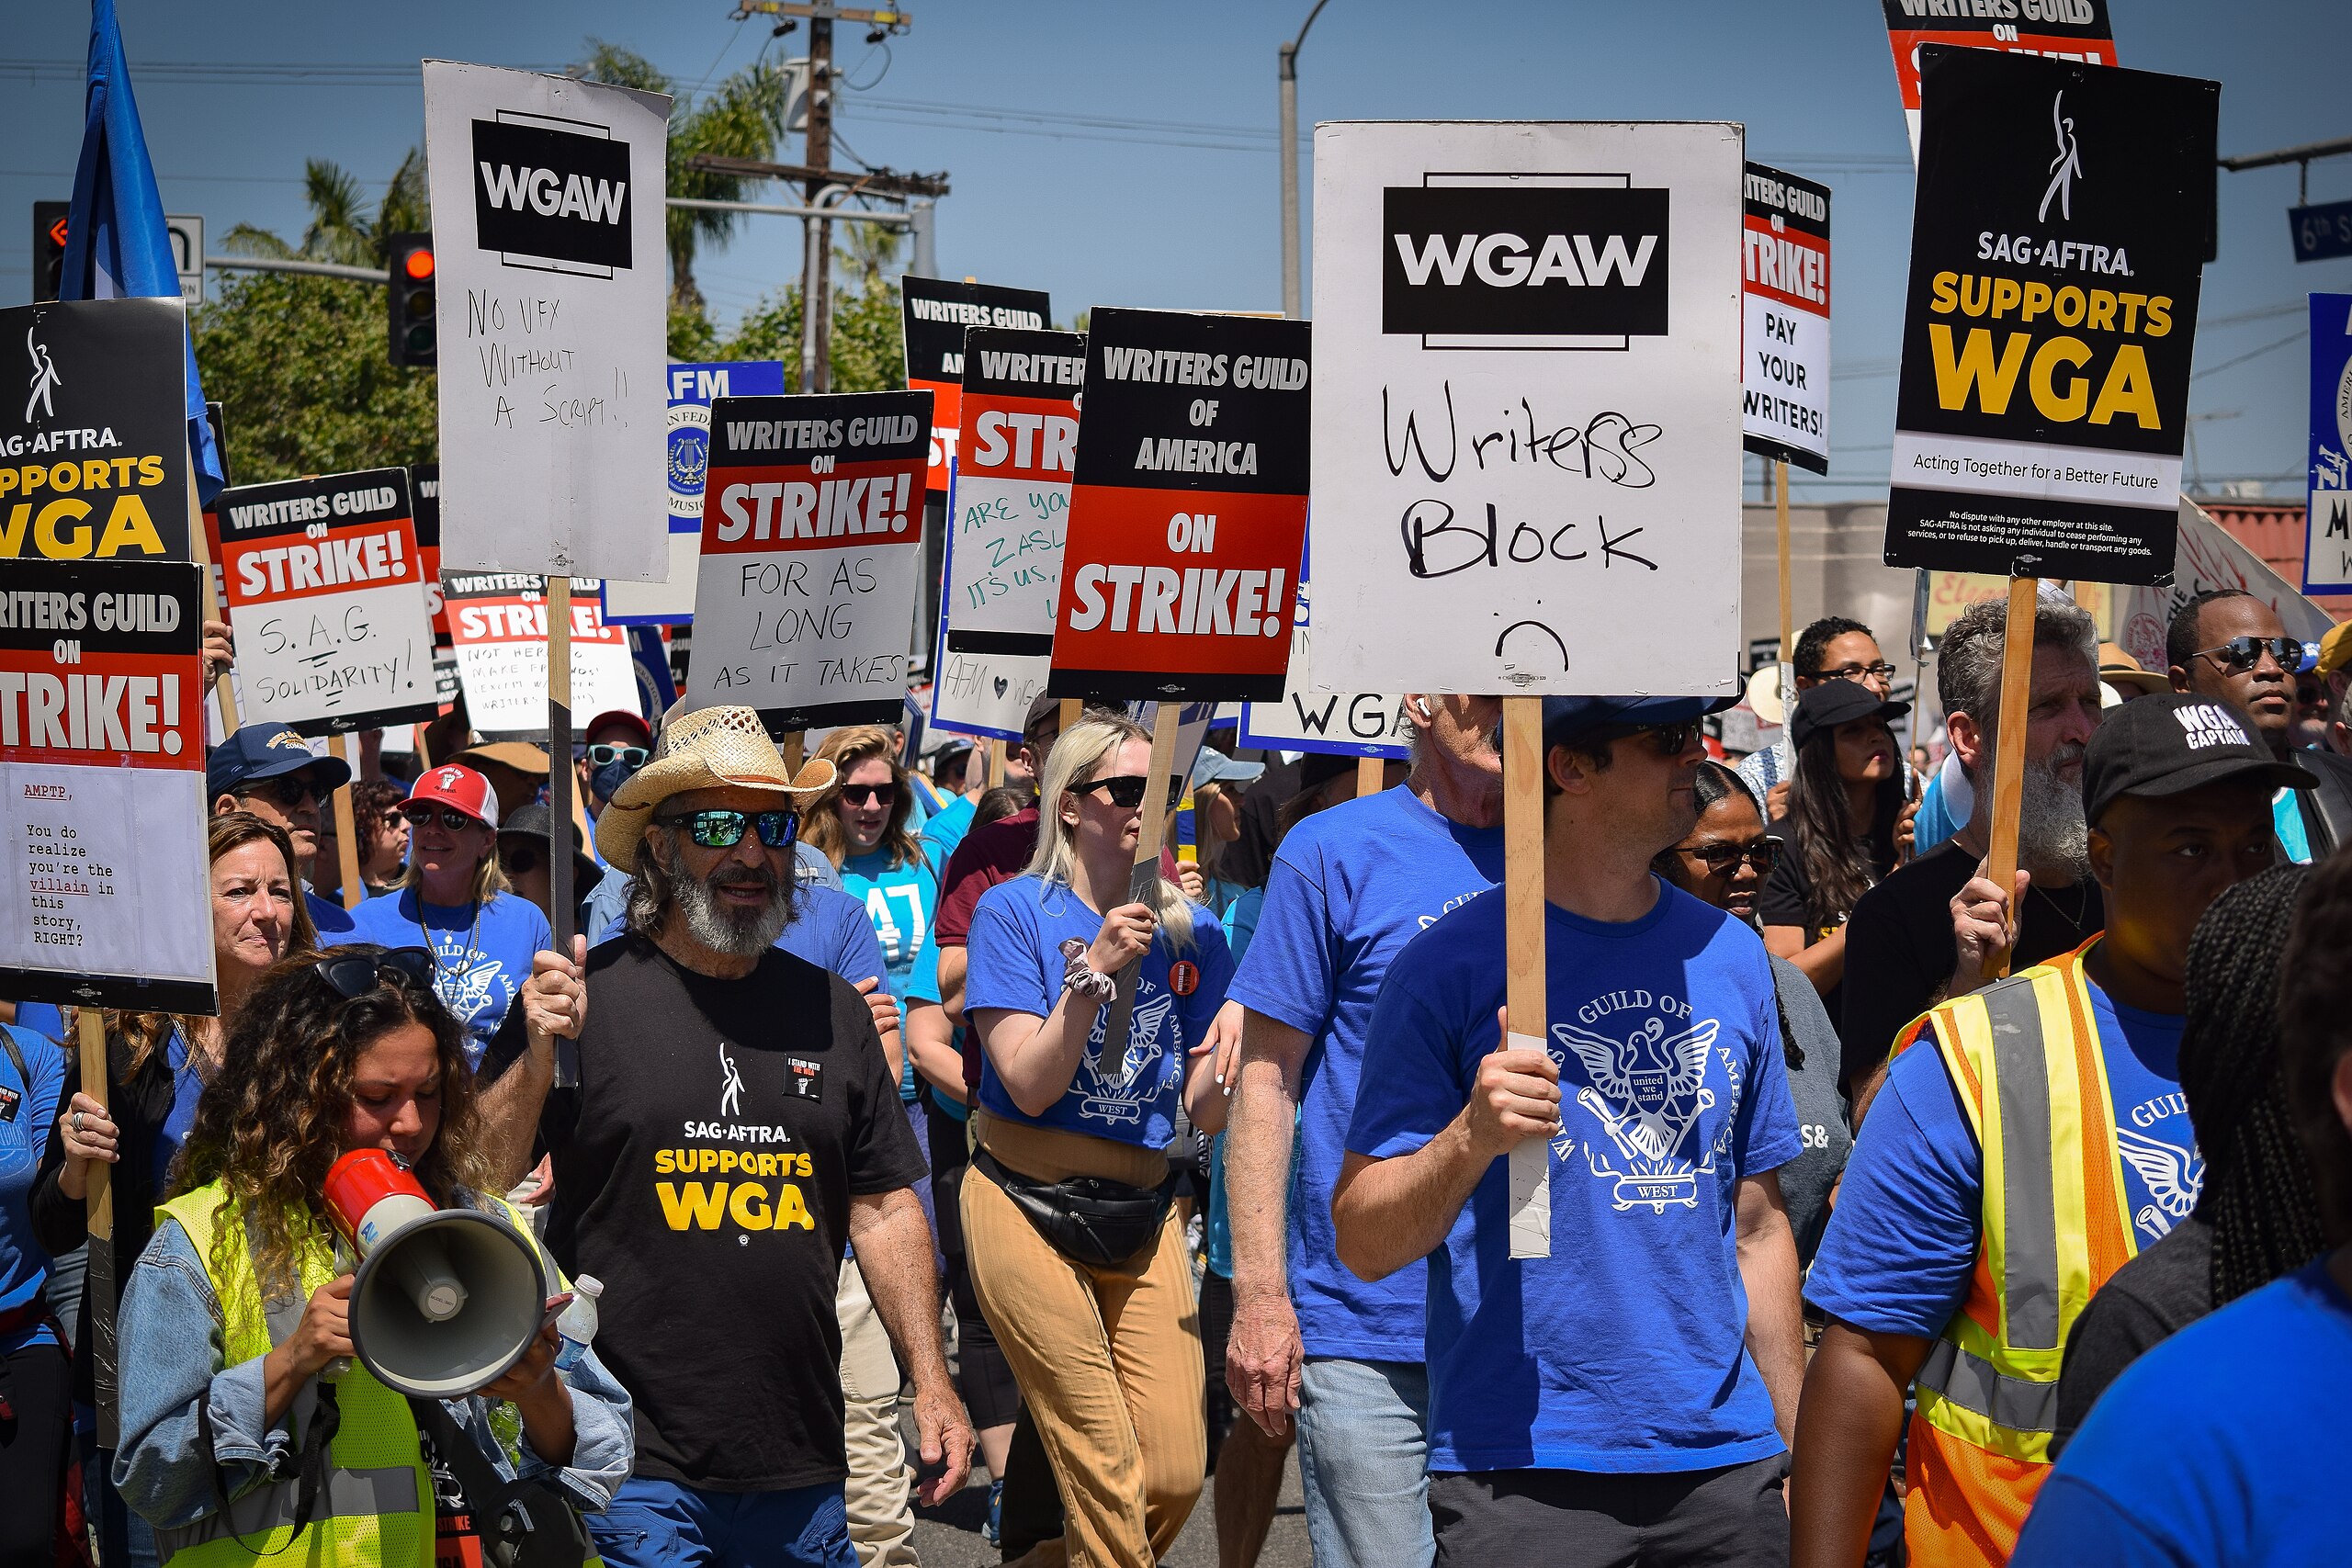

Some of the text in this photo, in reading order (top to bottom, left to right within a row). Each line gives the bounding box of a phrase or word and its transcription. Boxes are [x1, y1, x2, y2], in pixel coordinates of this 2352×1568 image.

[1993, 24, 2018, 41] ON
[480, 161, 626, 225] WGAW
[1745, 173, 1826, 223] ITERS GUILD
[1770, 213, 1784, 233] ON
[1394, 232, 1657, 288] WGAW
[1745, 229, 1826, 306] TRIKE!
[469, 289, 560, 338] NO VFX
[910, 299, 1043, 330] WRITERS GUILD
[1930, 271, 2173, 337] SUPPORTS
[1766, 311, 1797, 346] PAY
[980, 350, 1086, 385] WRITER
[1103, 347, 1308, 391] WRITERS GUILD
[1758, 351, 1807, 390] YOUR
[1929, 323, 2161, 430] WGA
[494, 396, 514, 428] A
[1189, 399, 1219, 427] OF
[726, 419, 844, 451] WRITERS
[848, 415, 919, 446] GUILD
[810, 455, 835, 474] ON
[1135, 437, 1258, 475] AMERICA
[1914, 453, 2159, 489] Acting Together for a Better Future
[230, 495, 330, 530] WRITERS
[333, 487, 397, 515] GUILD
[718, 473, 912, 542] STRIKE!
[1950, 511, 1960, 520] No
[1961, 512, 1987, 523] dispute
[1988, 513, 2005, 523] with
[2007, 516, 2020, 525] any
[2021, 516, 2041, 526] other
[2042, 520, 2075, 530] employer
[2085, 522, 2098, 531] this
[2099, 524, 2114, 532] site.
[306, 523, 328, 539] ON
[1167, 513, 1216, 553] ON
[1907, 529, 1938, 539] services,
[1948, 532, 1955, 540] to
[1957, 532, 1978, 542] refuse
[1979, 535, 1987, 543] to
[1988, 535, 2004, 544] pick
[2006, 537, 2018, 546] up,
[2018, 537, 2044, 547] deliver,
[2045, 539, 2069, 549] handle
[2079, 543, 2112, 553] transport
[2114, 547, 2127, 555] any
[2128, 547, 2153, 556] goods.
[1962, 522, 1967, 531] is
[1968, 523, 1981, 532] not
[1982, 525, 2006, 535] asking
[2007, 526, 2021, 536] any
[2022, 527, 2056, 537] individual
[2058, 530, 2065, 538] to
[2087, 534, 2128, 545] performing
[2129, 537, 2143, 547] any
[238, 530, 407, 596] STRIKE!
[741, 558, 877, 597] FOR AS
[450, 573, 600, 593] WRITERS ILD
[521, 591, 540, 602] ON
[0, 591, 180, 632] ITERS GUILD
[1069, 563, 1286, 638] STRIKE!
[260, 605, 377, 654] S.A.G.
[750, 603, 853, 650] LONG
[53, 638, 81, 664] ON
[468, 647, 548, 661] NOT HER
[256, 638, 413, 704] SOLIDARITY!
[472, 664, 519, 678] MAKE
[713, 655, 905, 690] AS IT TAKES
[944, 654, 988, 708] AFM
[0, 671, 183, 755] TRIKE!
[2173, 704, 2240, 732] WGA
[2186, 728, 2250, 750] CAPTAIN
[24, 784, 74, 802] AMPTP,
[27, 824, 77, 839] You do
[28, 843, 86, 857] realize
[29, 861, 113, 876] you're the
[30, 879, 114, 896] villain in
[32, 897, 64, 908] this
[33, 914, 82, 931] story,
[34, 931, 83, 947] RIGHT?
[1578, 990, 1693, 1024] GUILD OF
[791, 1059, 807, 1067] STAND
[808, 1062, 820, 1071] WITH
[1165, 1014, 1183, 1091] AMERICA
[1633, 1076, 1664, 1086] united
[1098, 1104, 1127, 1115] WEST
[1637, 1092, 1664, 1102] stand
[655, 1149, 813, 1177] SUPPORTS
[655, 1182, 815, 1230] WGA
[1637, 1185, 1679, 1198] WEST
[436, 1515, 470, 1532] STRIKE
